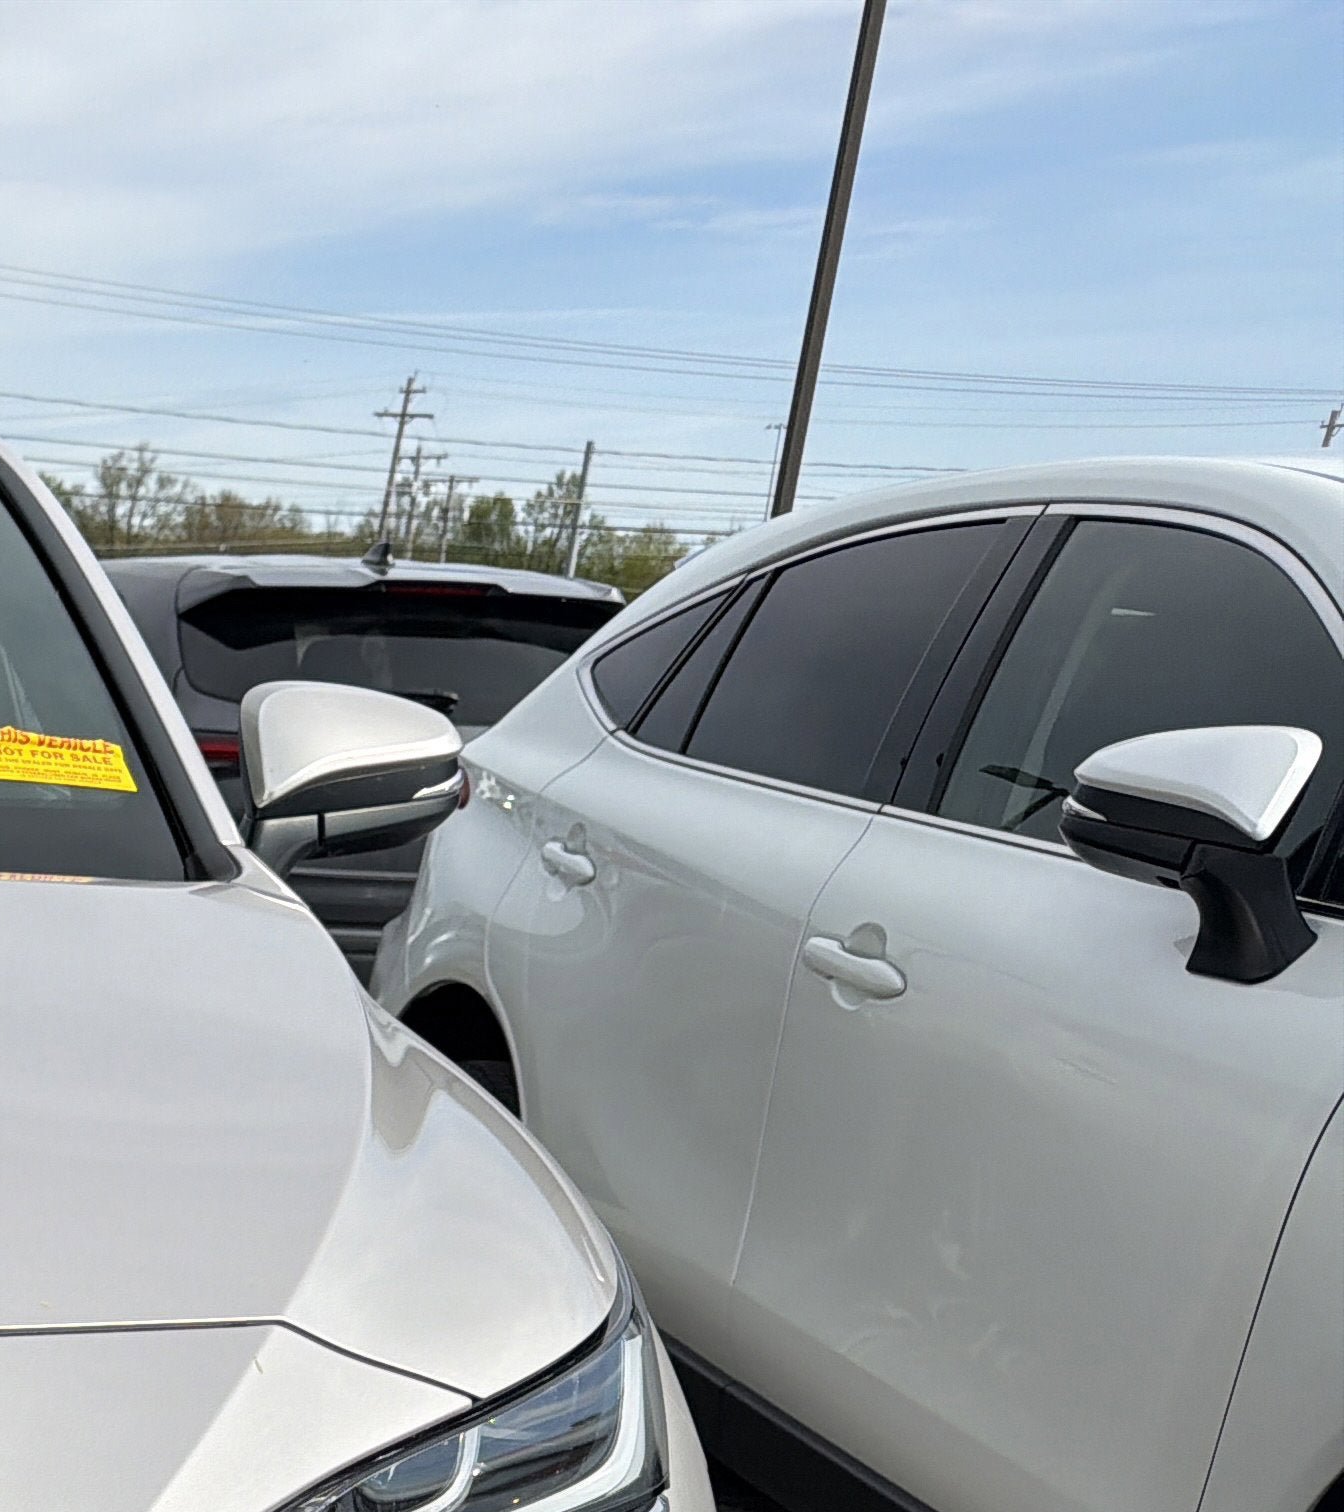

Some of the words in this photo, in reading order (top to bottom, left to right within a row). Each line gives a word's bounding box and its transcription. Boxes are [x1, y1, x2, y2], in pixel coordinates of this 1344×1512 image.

[37, 735, 115, 755] VEHICLE
[29, 749, 64, 761] FOR
[70, 753, 113, 766] SALE
